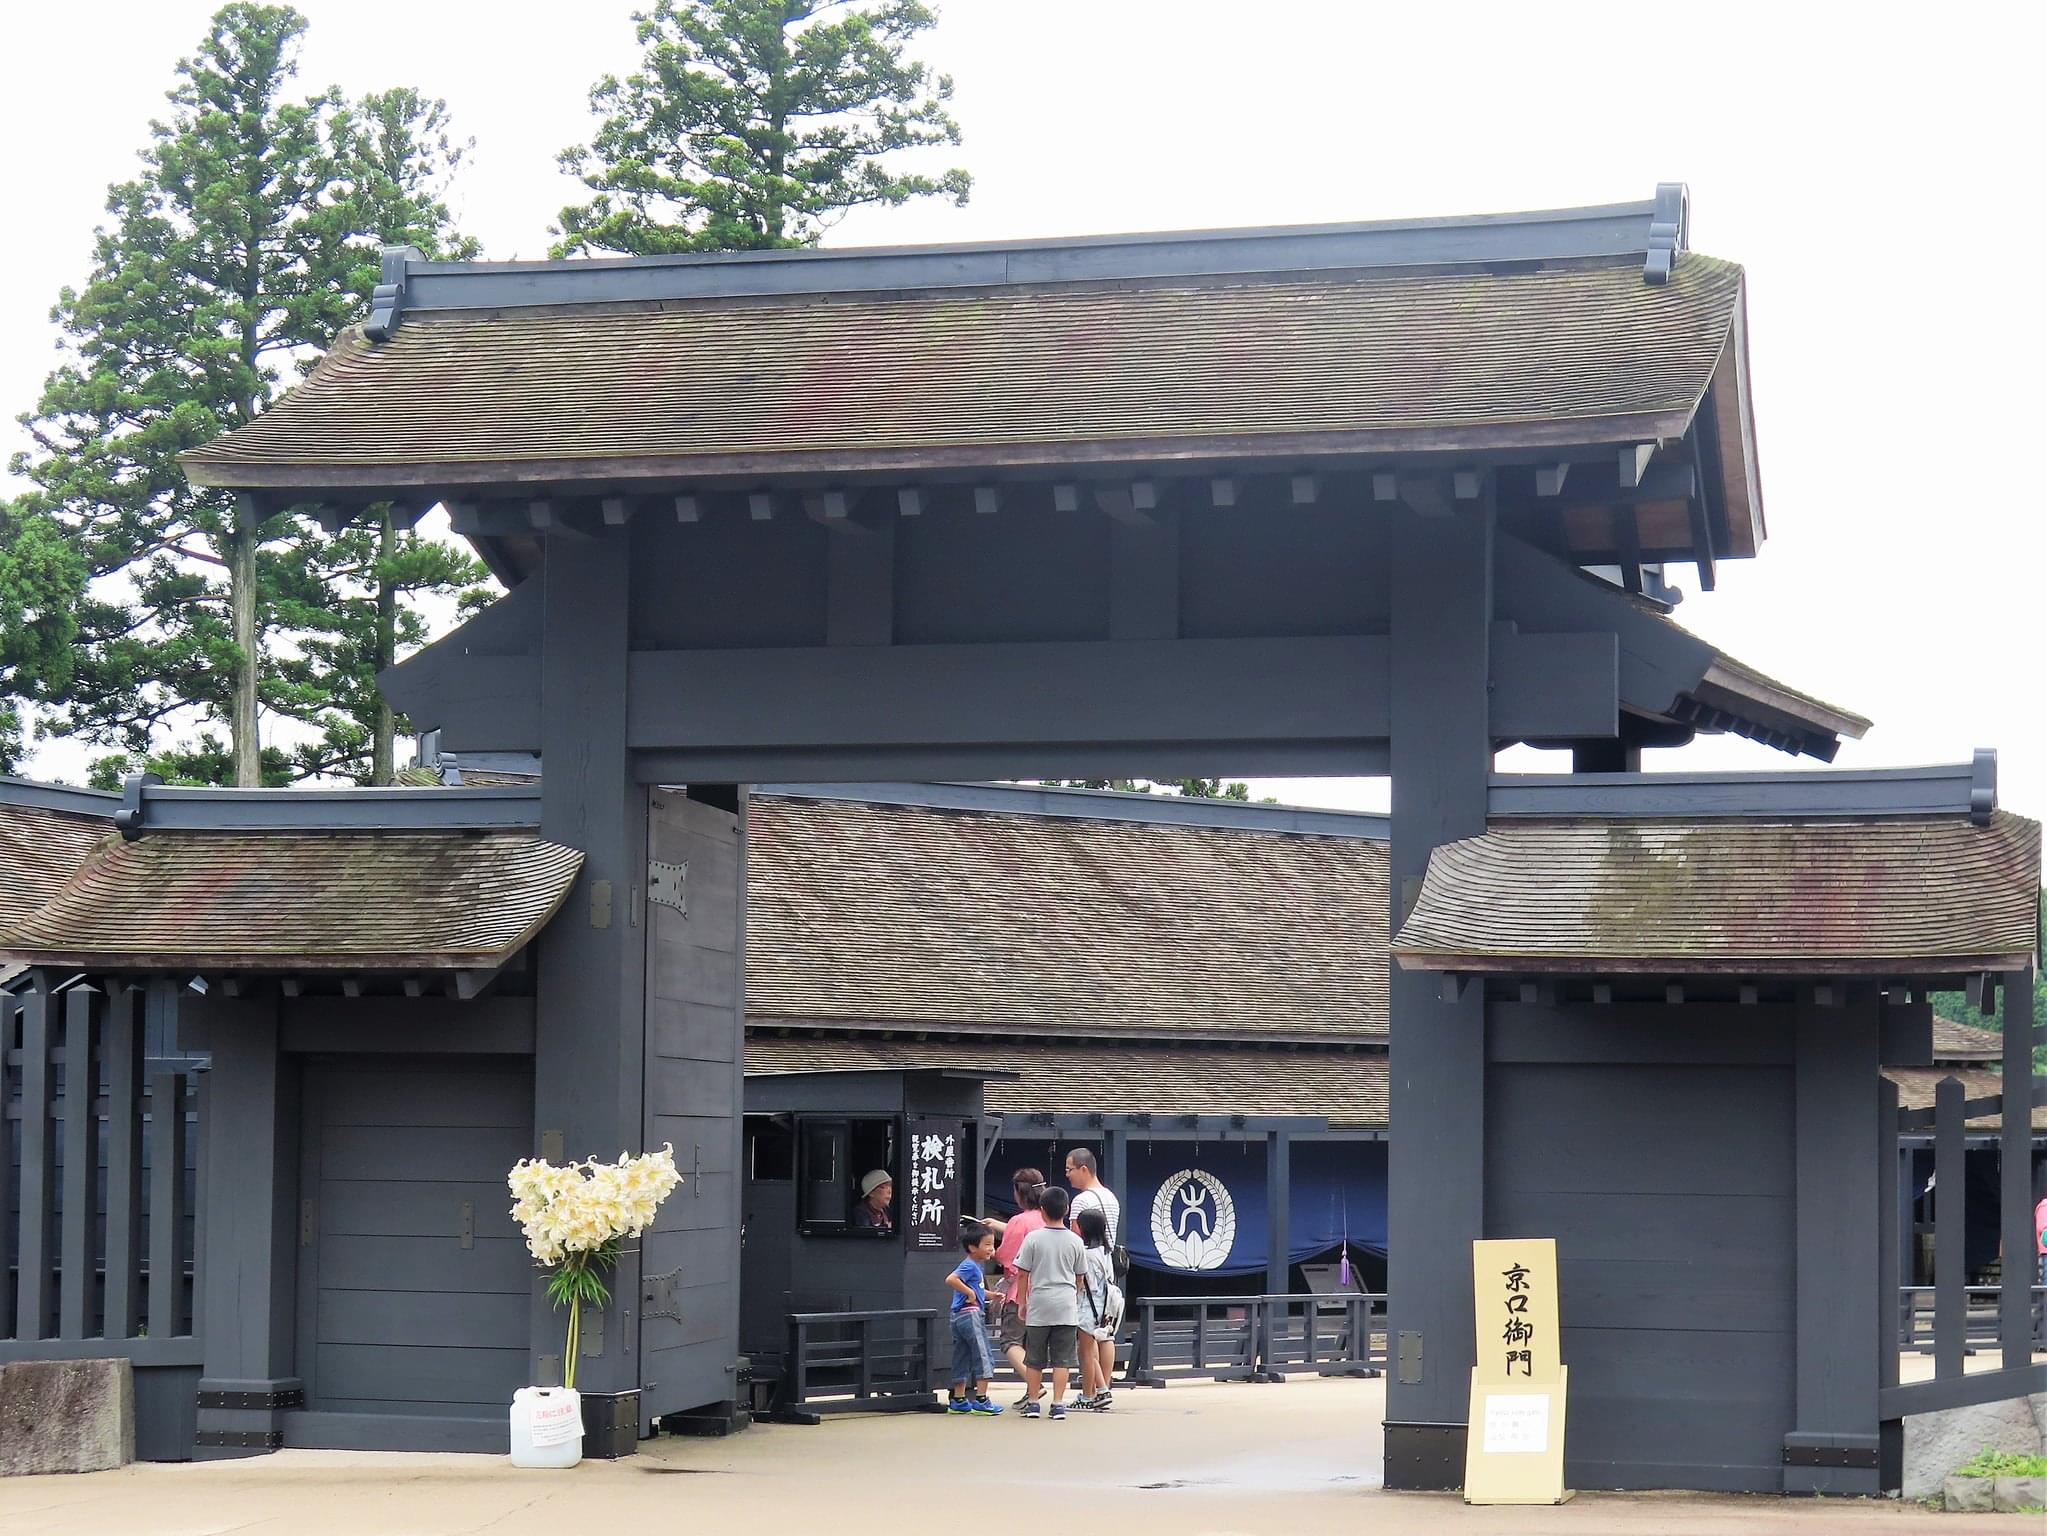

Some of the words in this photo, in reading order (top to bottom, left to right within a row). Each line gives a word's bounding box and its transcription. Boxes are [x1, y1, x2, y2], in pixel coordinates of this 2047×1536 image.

[919, 1134, 945, 1226] 検札所
[1501, 1262, 1533, 1377] 京口御門
